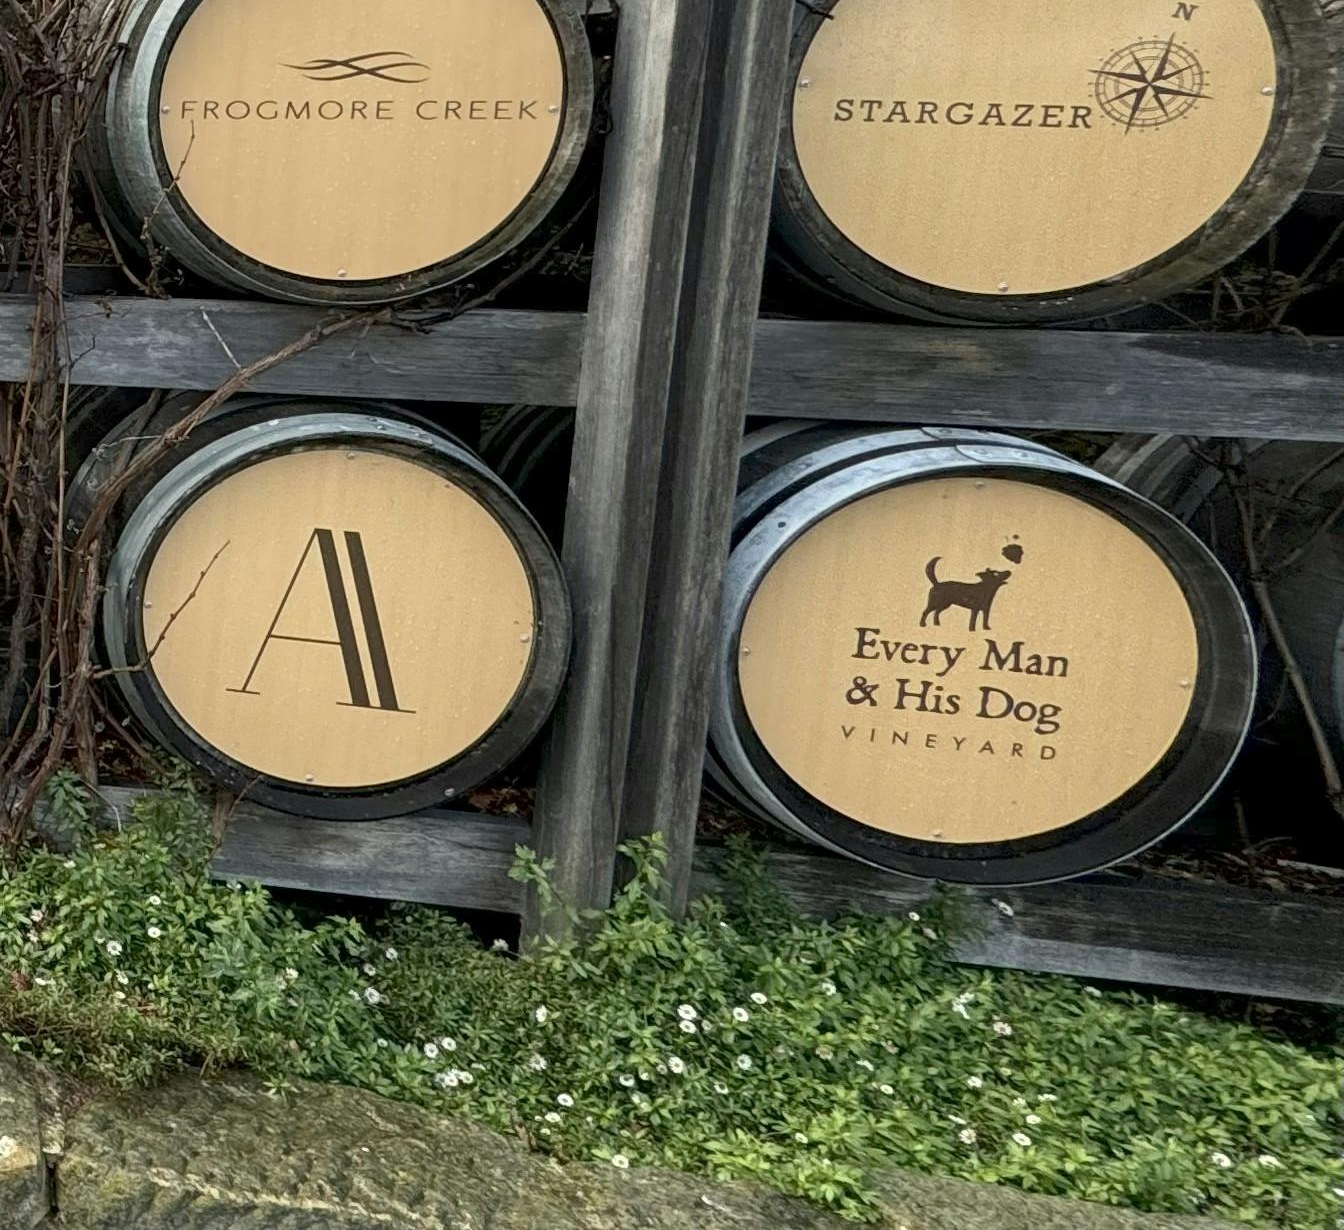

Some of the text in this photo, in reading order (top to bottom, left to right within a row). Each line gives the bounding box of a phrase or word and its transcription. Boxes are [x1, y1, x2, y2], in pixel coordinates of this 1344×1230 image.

[1171, 2, 1200, 21] N
[181, 100, 538, 120] FROGMORE CREEK
[833, 98, 1094, 129] STARGAZER
[851, 627, 1069, 678] Every Man
[845, 676, 1062, 735] & His Dog
[841, 725, 1057, 760] VINEYARD
